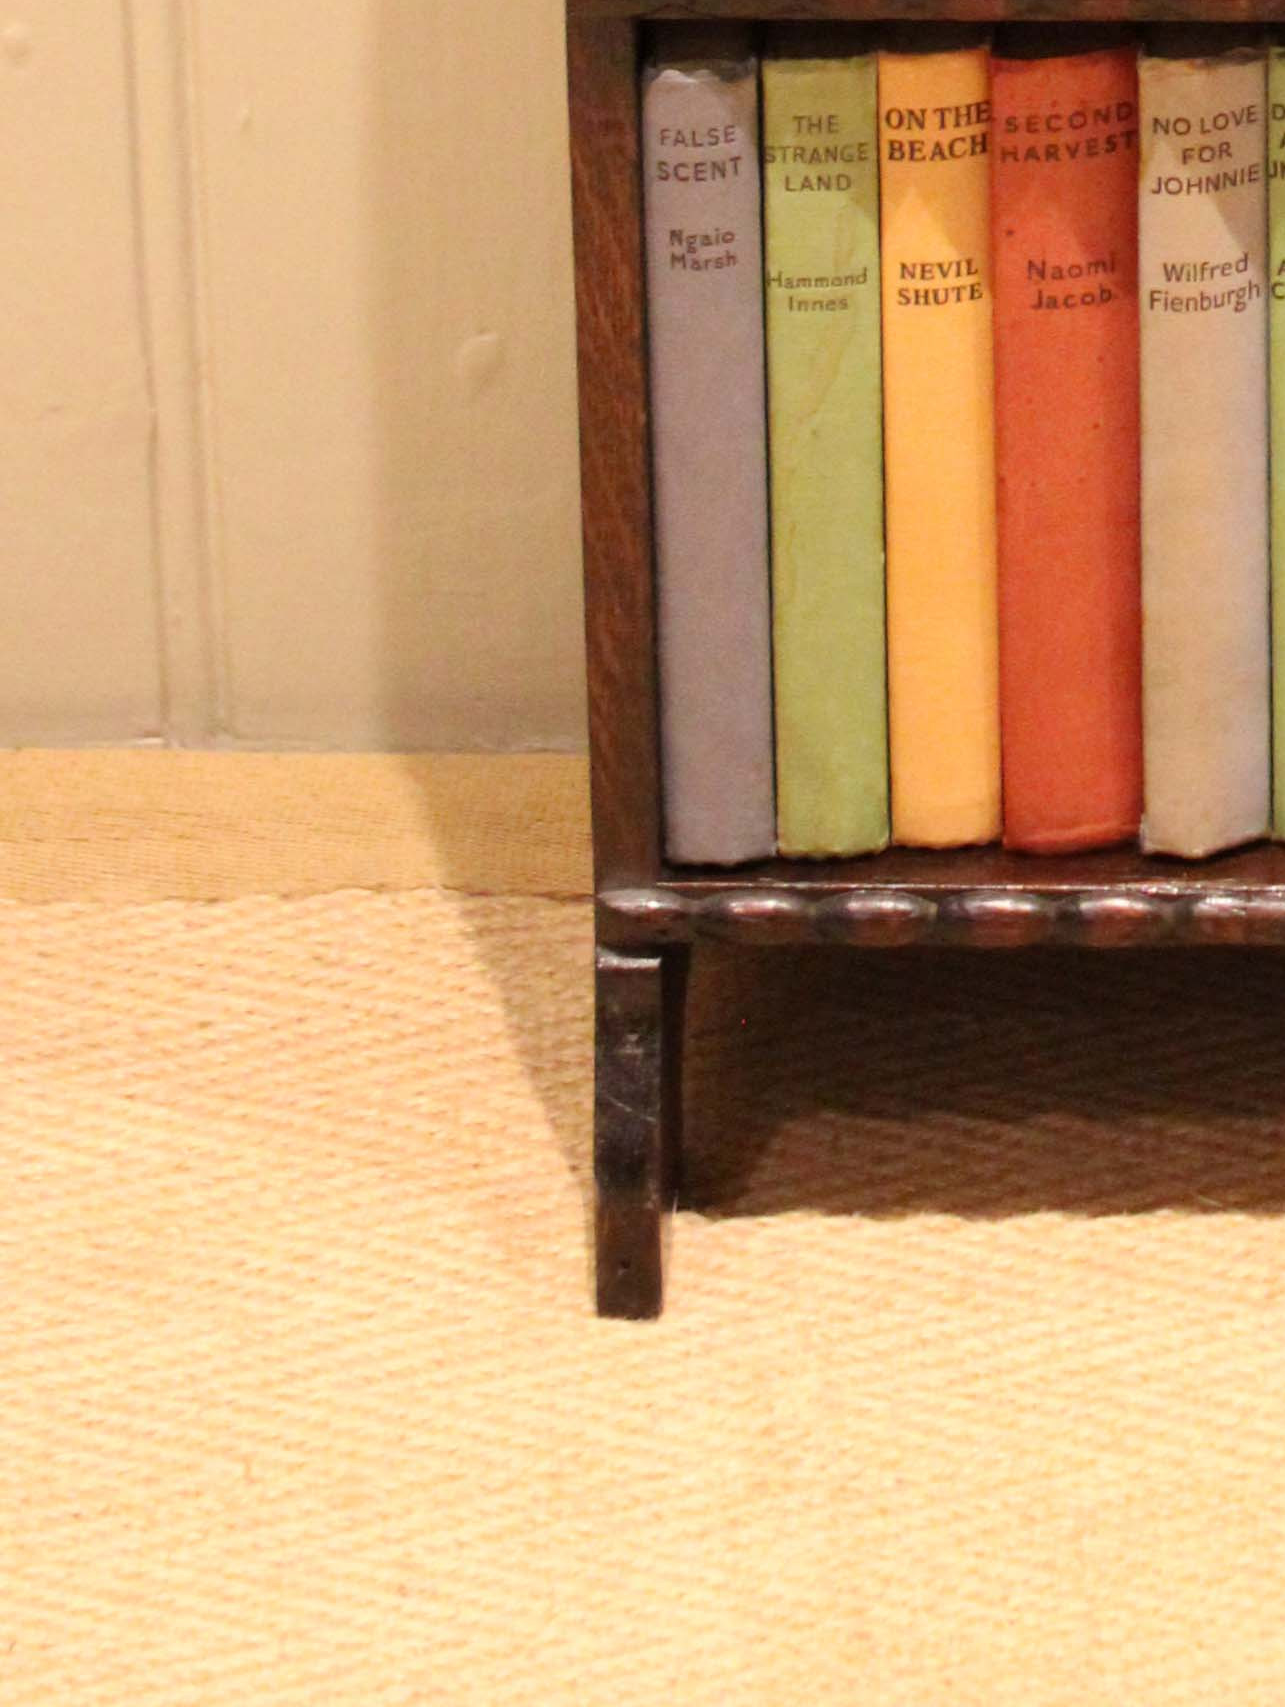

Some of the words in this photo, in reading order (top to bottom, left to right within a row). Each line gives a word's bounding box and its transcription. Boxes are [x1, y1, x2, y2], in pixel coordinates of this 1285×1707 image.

[793, 115, 840, 135] THE
[885, 108, 925, 132] ON
[931, 102, 990, 127] THE
[1006, 103, 1133, 134] SECOND
[1153, 116, 1191, 136] NO
[1201, 105, 1259, 134] LOVE
[660, 124, 737, 149] FALSE
[887, 136, 989, 162] BEACH
[1002, 131, 1135, 164] HARVEST
[766, 143, 869, 165] STRANGE
[1182, 142, 1233, 165] FOR
[657, 157, 742, 183] SCENT
[1150, 164, 1261, 196] JOHNNIE
[784, 175, 852, 192] LAND
[669, 228, 735, 254] Ngaio
[670, 252, 737, 270] Marsh
[900, 259, 978, 282] NEVIL
[1028, 256, 1117, 281] Naomi
[1164, 254, 1249, 282] Wilfred
[768, 270, 868, 288] Hammond
[788, 296, 848, 312] Innes
[898, 283, 983, 306] SHUTE
[1031, 288, 1112, 310] Jacob
[1150, 282, 1261, 313] Fienburgh
